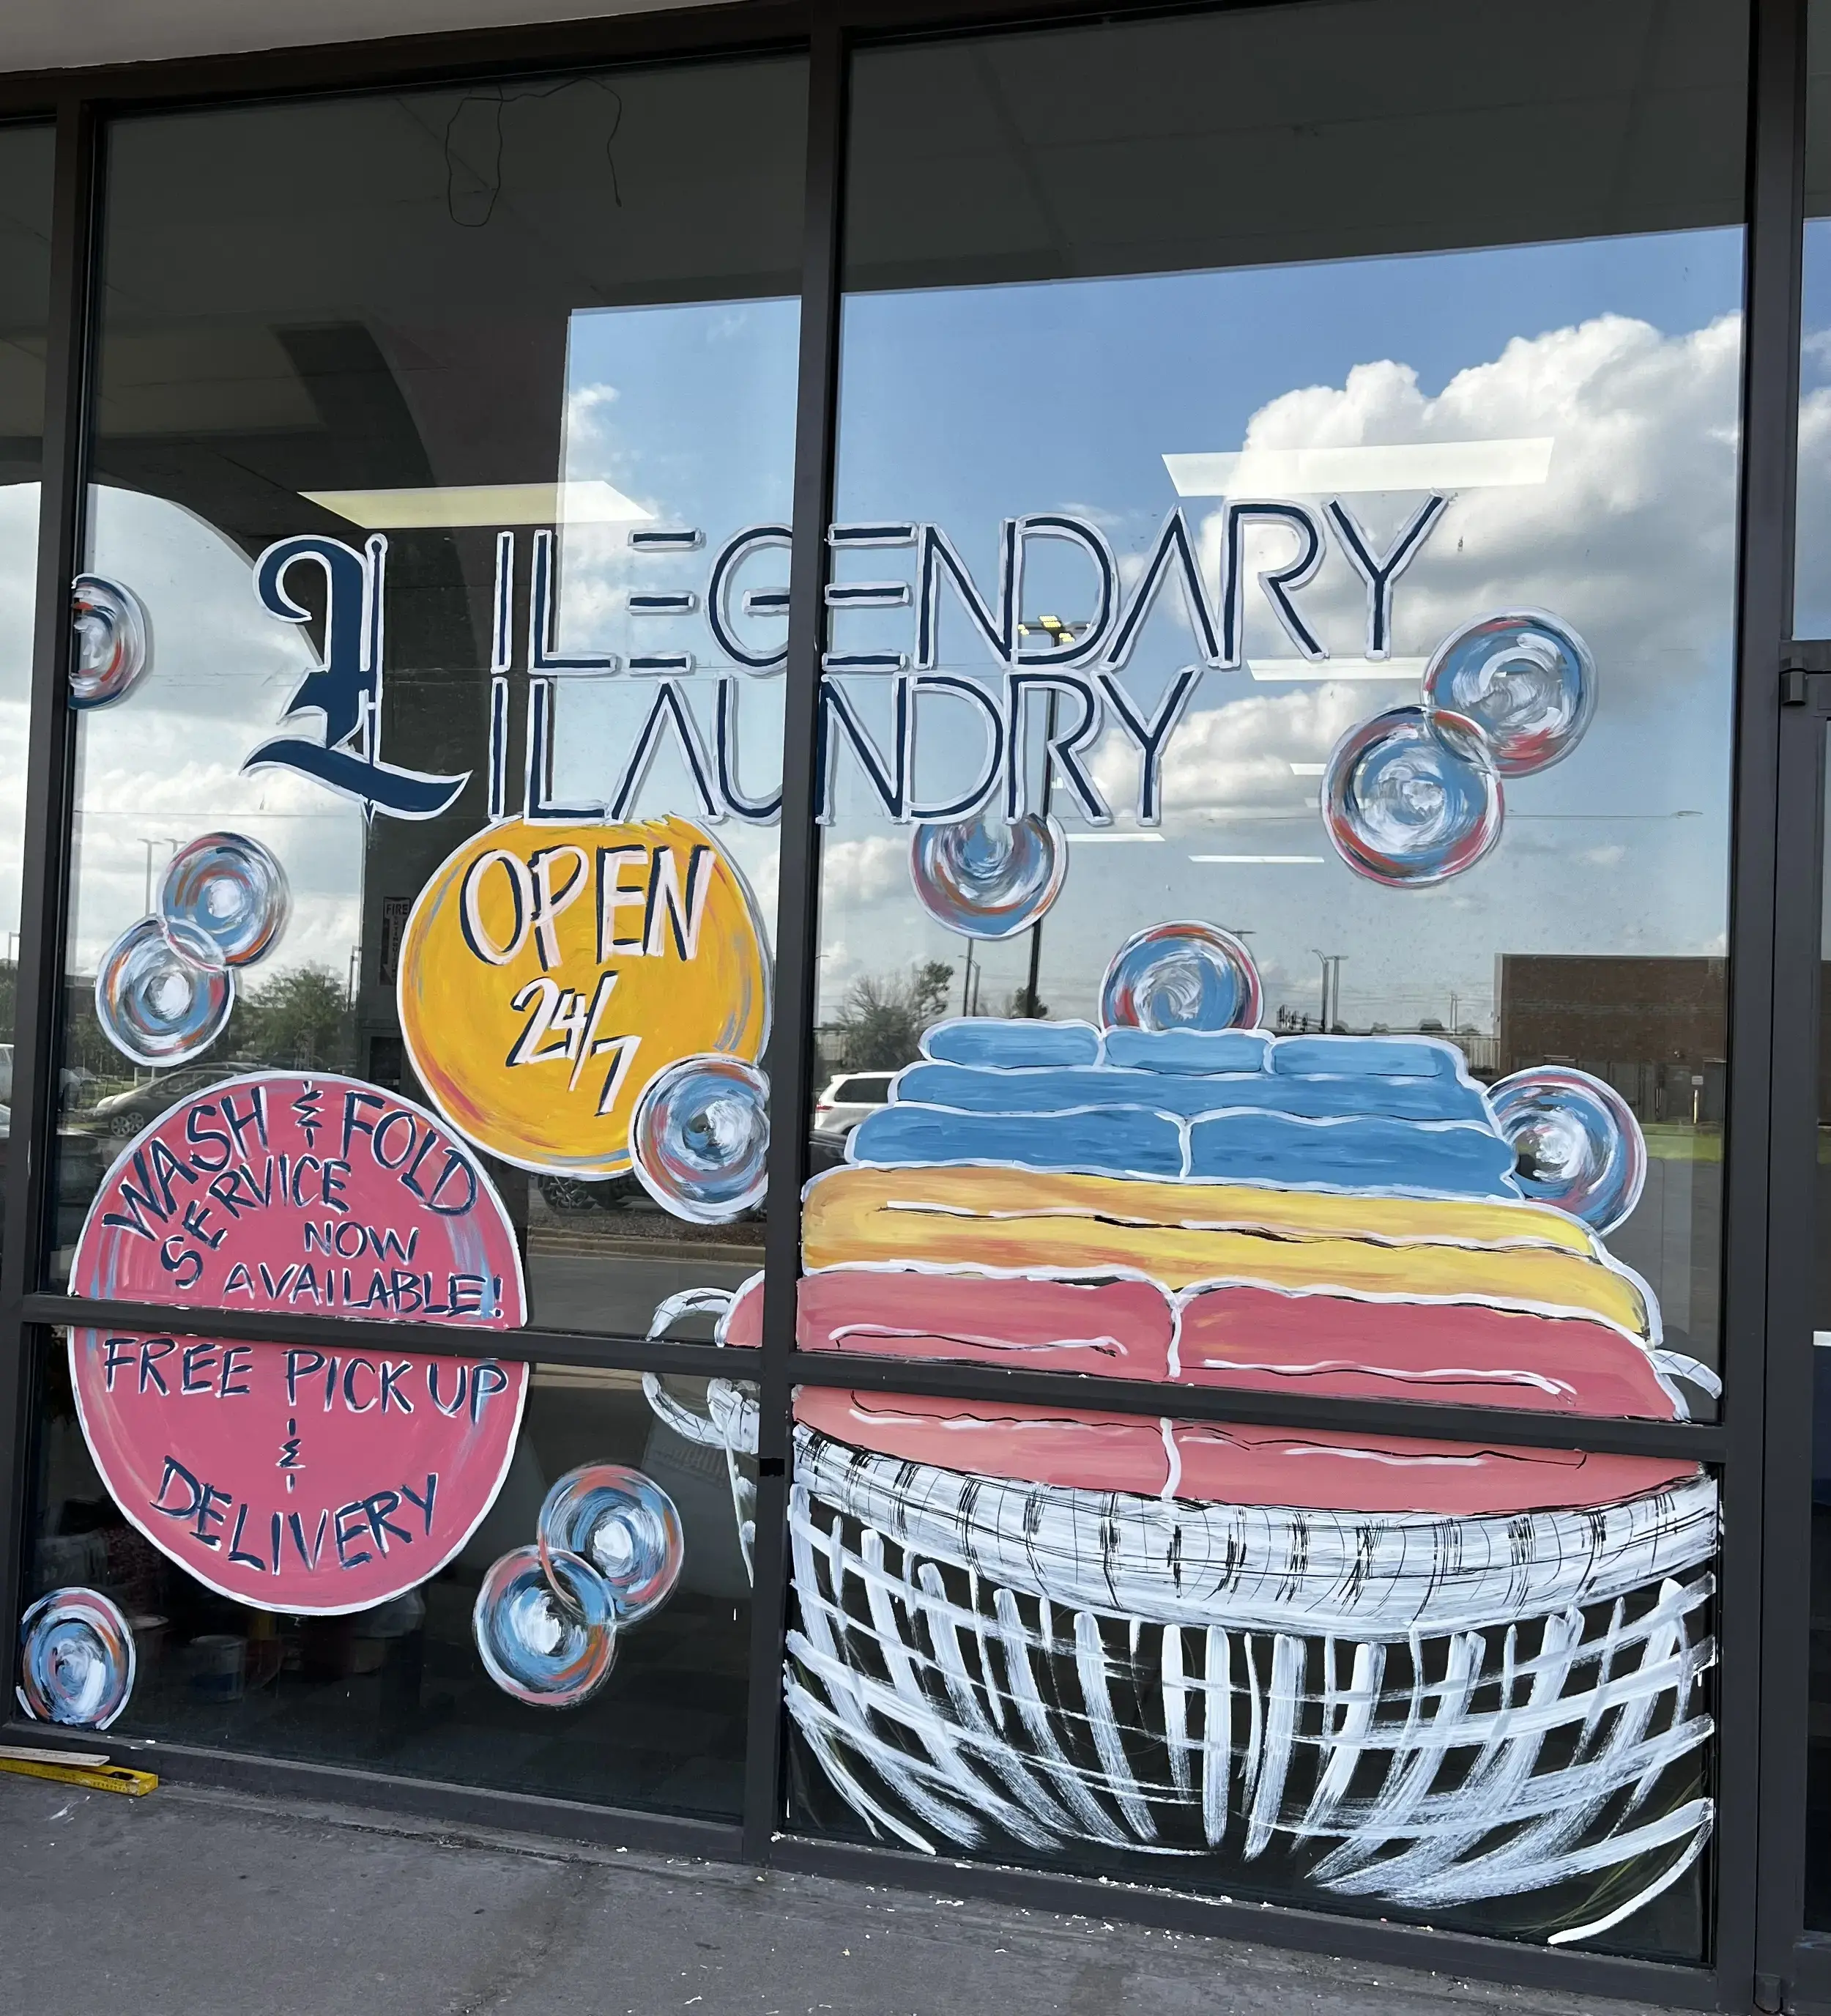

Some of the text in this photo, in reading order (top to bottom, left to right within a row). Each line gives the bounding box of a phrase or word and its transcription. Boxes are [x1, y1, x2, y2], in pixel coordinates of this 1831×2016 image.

[491, 488, 1450, 677] LEGENDARY
[488, 664, 1203, 826] LAUNDRY
[385, 903, 409, 916] FIRE
[459, 844, 717, 972] OPEN
[505, 970, 642, 1117] 24/7
[101, 1081, 478, 1242] WASH & FOLD
[160, 1152, 352, 1289] SERVICE
[223, 1261, 504, 1318] AVAILABLE!
[305, 1220, 419, 1266] NOW
[103, 1337, 509, 1425] FREE PICK UP
[149, 1455, 438, 1575] DELIVERY
[275, 1418, 305, 1494] &
